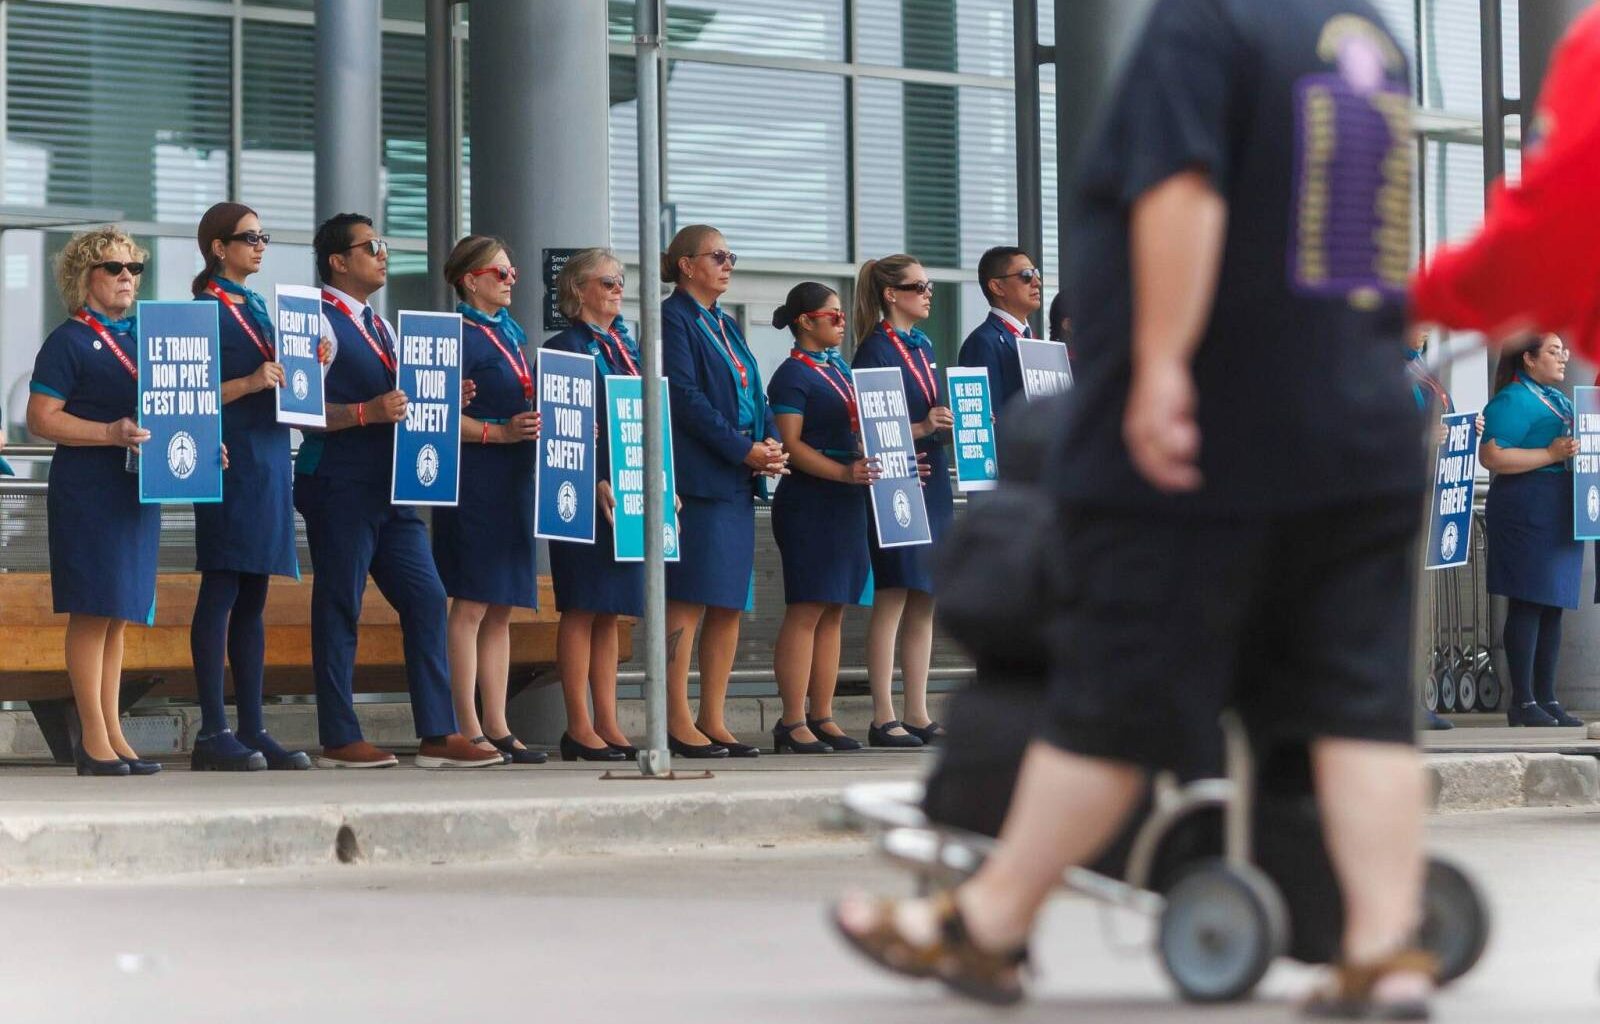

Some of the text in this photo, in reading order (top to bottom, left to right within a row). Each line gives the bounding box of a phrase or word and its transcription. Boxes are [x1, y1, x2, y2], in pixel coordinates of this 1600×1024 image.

[280, 310, 319, 336] READY TO
[148, 337, 211, 361] LE TRAVAIL
[403, 336, 433, 365] HERE
[436, 337, 458, 367] FOR
[153, 359, 209, 388] NON PAYÉ
[415, 369, 446, 399] YOUR
[143, 391, 219, 415] C'EST DU VOL
[543, 373, 592, 407] HERE FOR
[954, 382, 982, 397] WE NEVER
[405, 402, 449, 432] SAFETY
[616, 397, 631, 420] WE
[861, 390, 905, 418] HERE FOR
[554, 407, 582, 438] YOUR
[621, 422, 643, 443] STOP
[876, 421, 902, 448] YOUR
[1449, 417, 1471, 452] PRÊT
[547, 439, 585, 471] SAFETY
[625, 446, 643, 467] CAR
[619, 469, 643, 491] ABOU
[1438, 454, 1474, 485] POUR LA
[1440, 482, 1468, 515] GRÈVE
